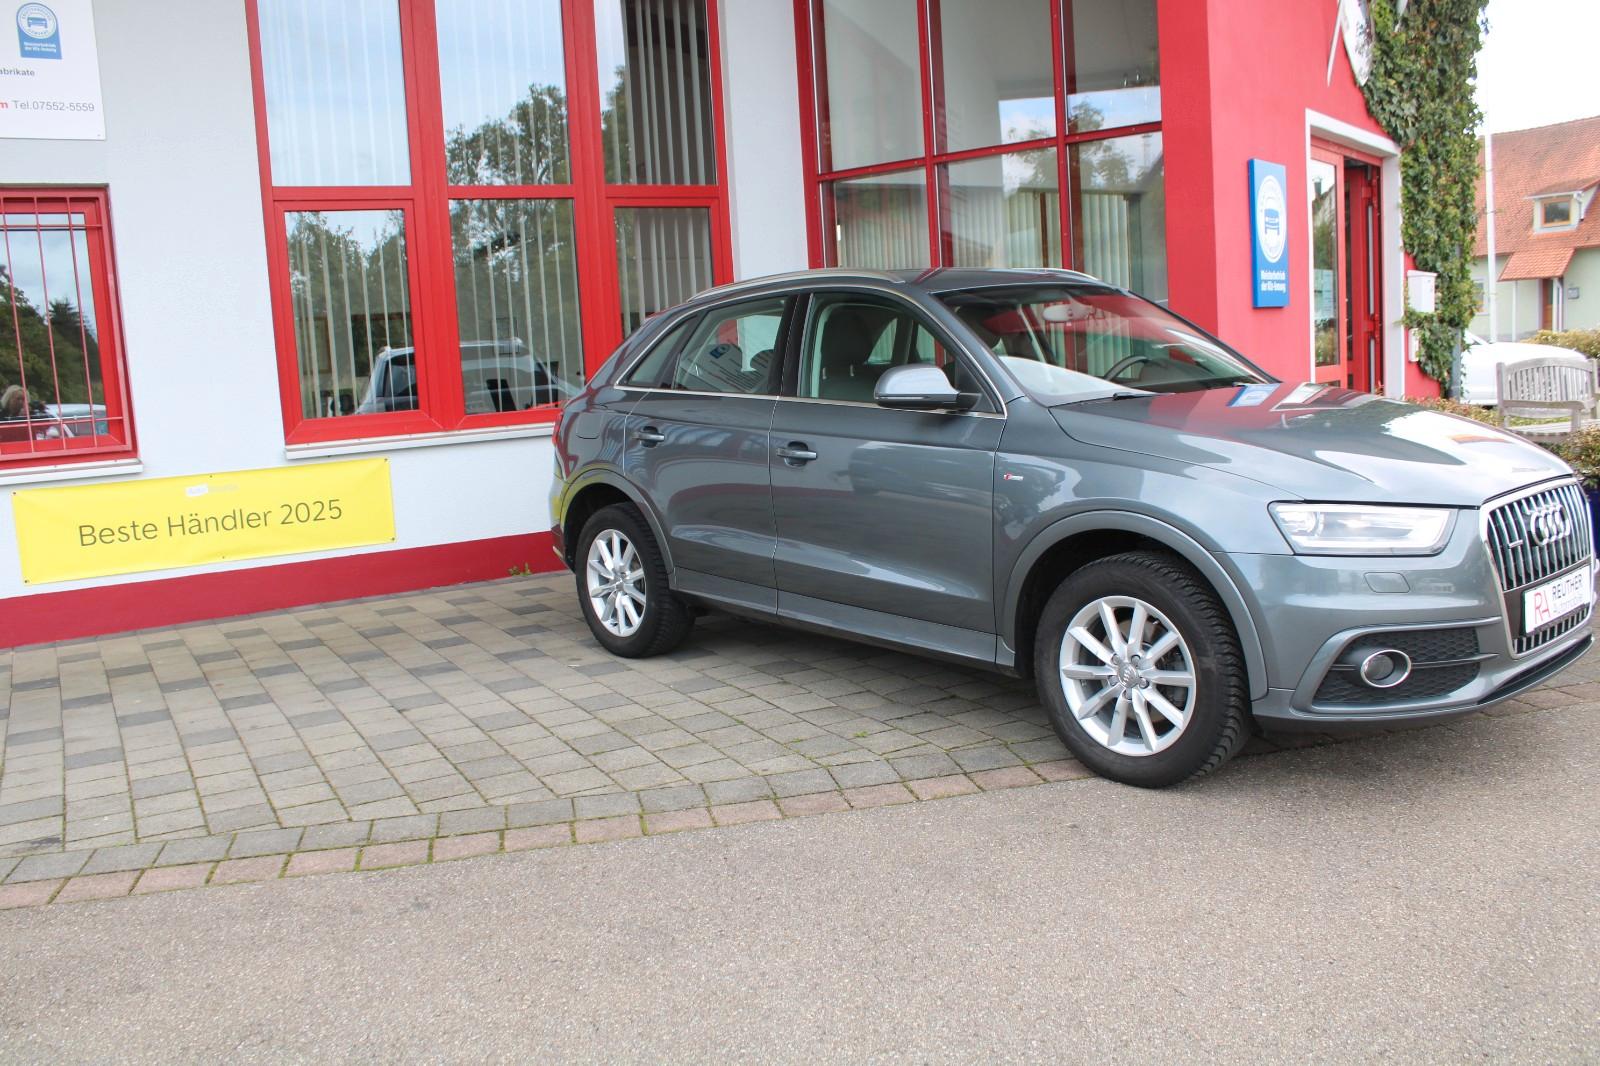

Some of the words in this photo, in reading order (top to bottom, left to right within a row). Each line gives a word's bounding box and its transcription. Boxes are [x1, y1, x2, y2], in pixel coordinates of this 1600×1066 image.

[78, 520, 158, 547] Beste
[167, 508, 272, 537] Händler
[280, 499, 342, 525] 2025
[1552, 574, 1583, 601] REUTHER
